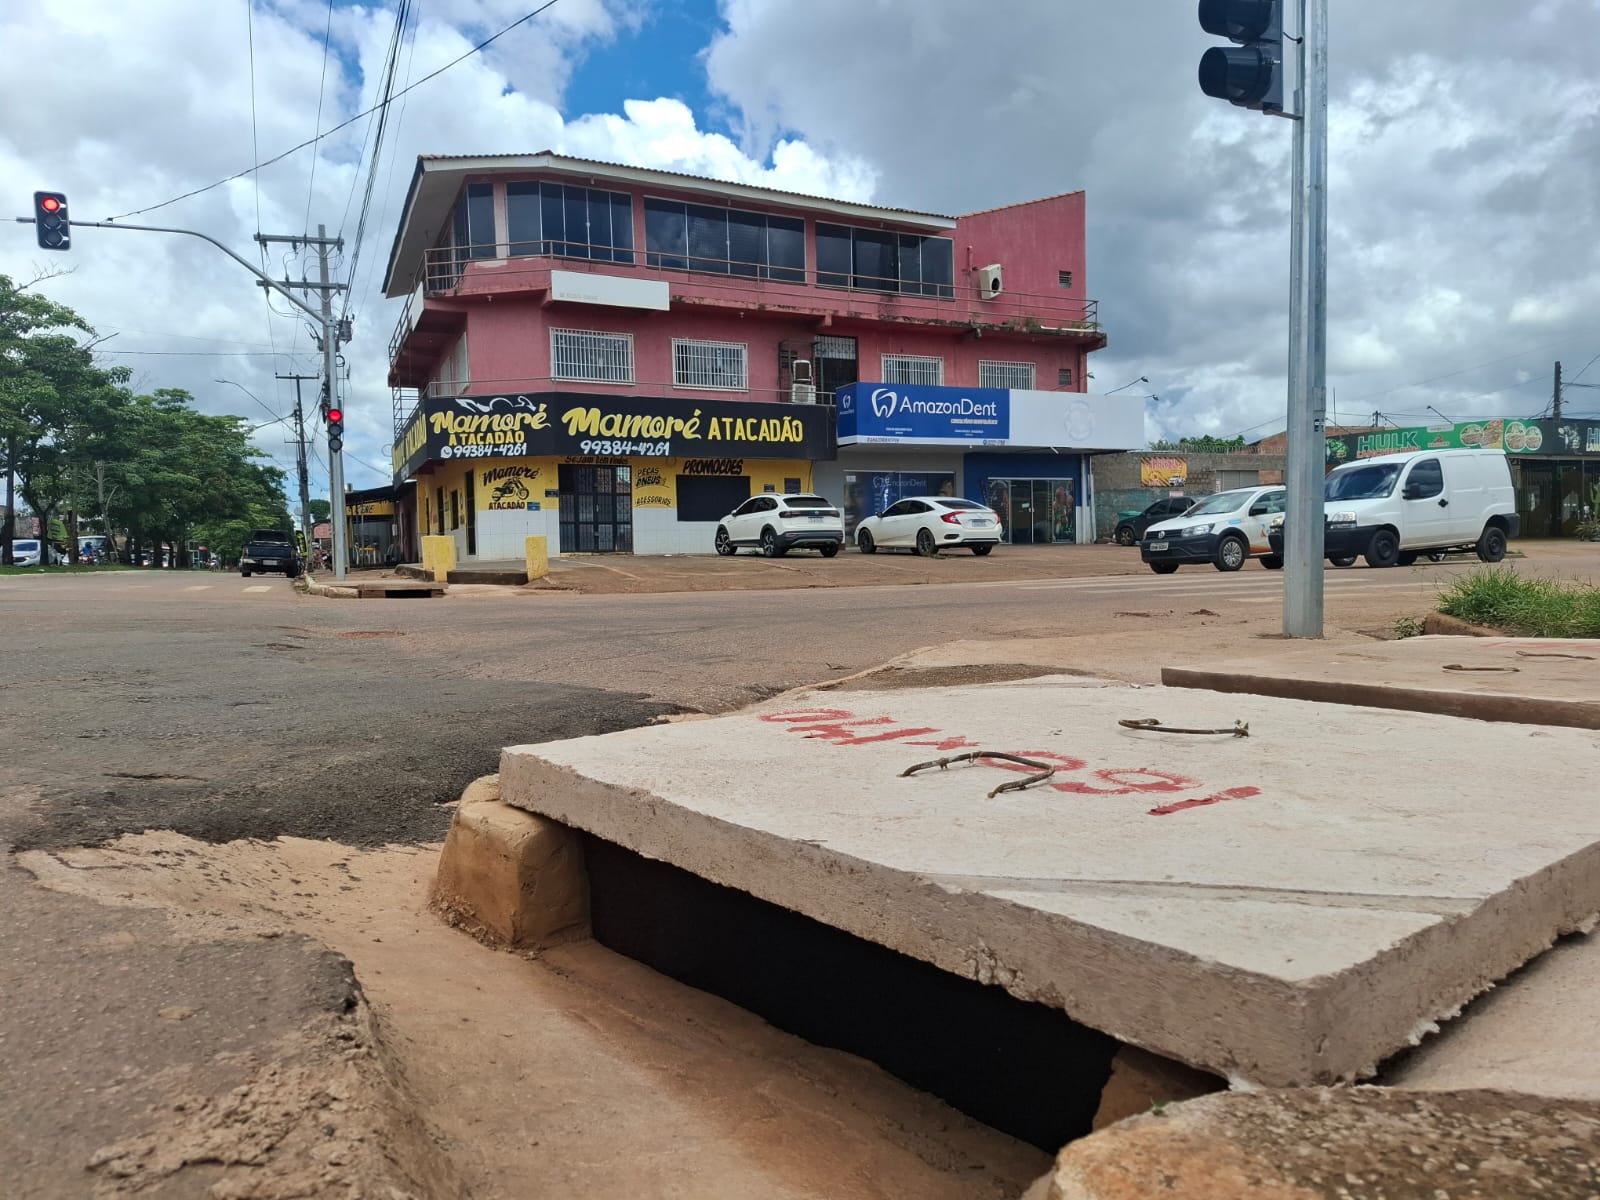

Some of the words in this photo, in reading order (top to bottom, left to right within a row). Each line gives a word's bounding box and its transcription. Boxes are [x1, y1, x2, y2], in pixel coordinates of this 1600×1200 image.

[899, 395, 998, 417] AmazonDent
[429, 403, 552, 434] Mamoré
[561, 407, 702, 439] Mamoré
[707, 416, 803, 442] ATACADÃO
[448, 430, 525, 446] ATACADÃO
[580, 440, 670, 456] 99384-4261
[1358, 431, 1418, 453] HULK
[453, 443, 527, 458] 99384-4261
[482, 465, 541, 486] Mamoré
